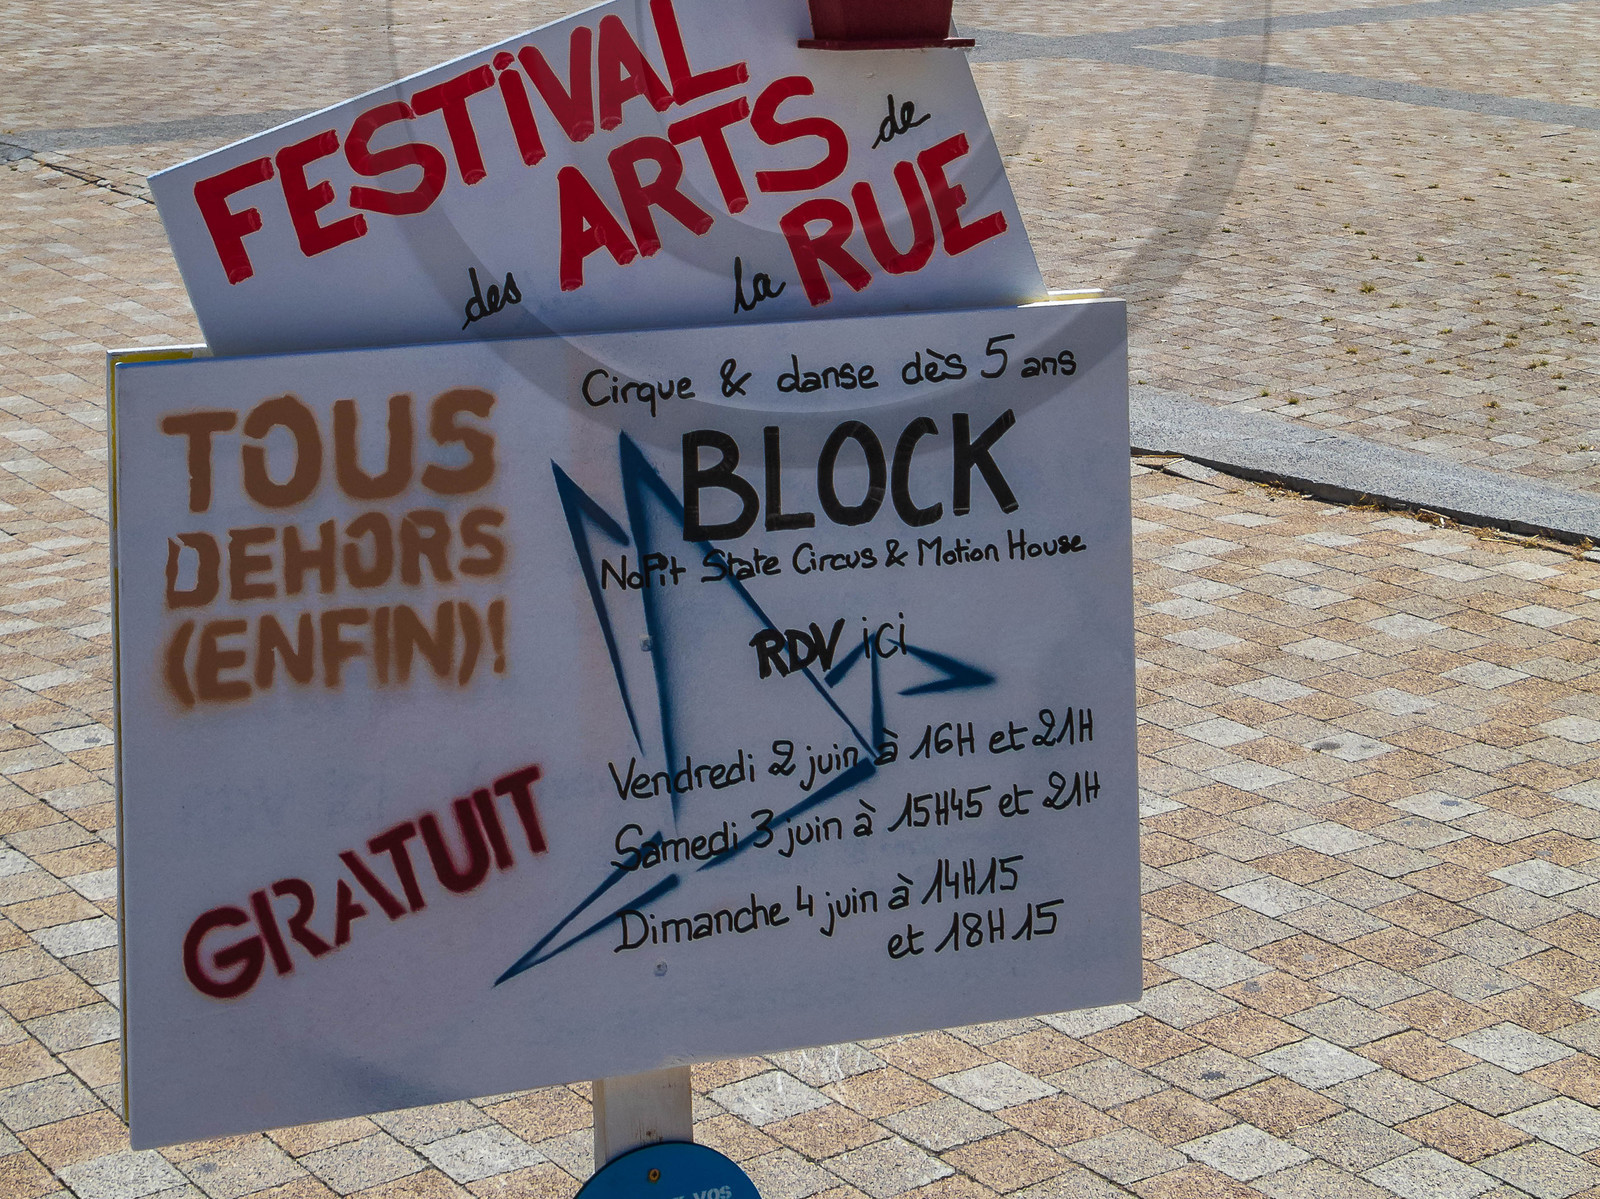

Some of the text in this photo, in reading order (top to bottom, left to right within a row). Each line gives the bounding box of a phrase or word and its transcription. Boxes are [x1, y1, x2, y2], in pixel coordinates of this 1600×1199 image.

[462, 75, 932, 331] des ARTS de
[733, 132, 1007, 315] la RUE
[582, 334, 1077, 417] Cirque & danse dès 5 ans
[161, 387, 498, 514] TOUS
[682, 408, 1019, 542] BLOCK
[164, 507, 506, 610] DEHORS
[700, 547, 782, 584] State
[792, 543, 878, 574] Circus
[886, 539, 908, 567] &
[917, 537, 1000, 568] Motion
[1007, 528, 1087, 561] House
[164, 600, 506, 709] (ENFIN)!
[749, 612, 908, 679] RDV ici
[608, 707, 1094, 801] Vendredi 2 juin à 16H et 21H
[611, 770, 1101, 872] Samedi 3 juin à 15H45 et 21H
[182, 763, 548, 1000] GRATUIT
[614, 855, 1024, 954] Dimanche 4 juin à 14H15
[887, 924, 924, 960] et
